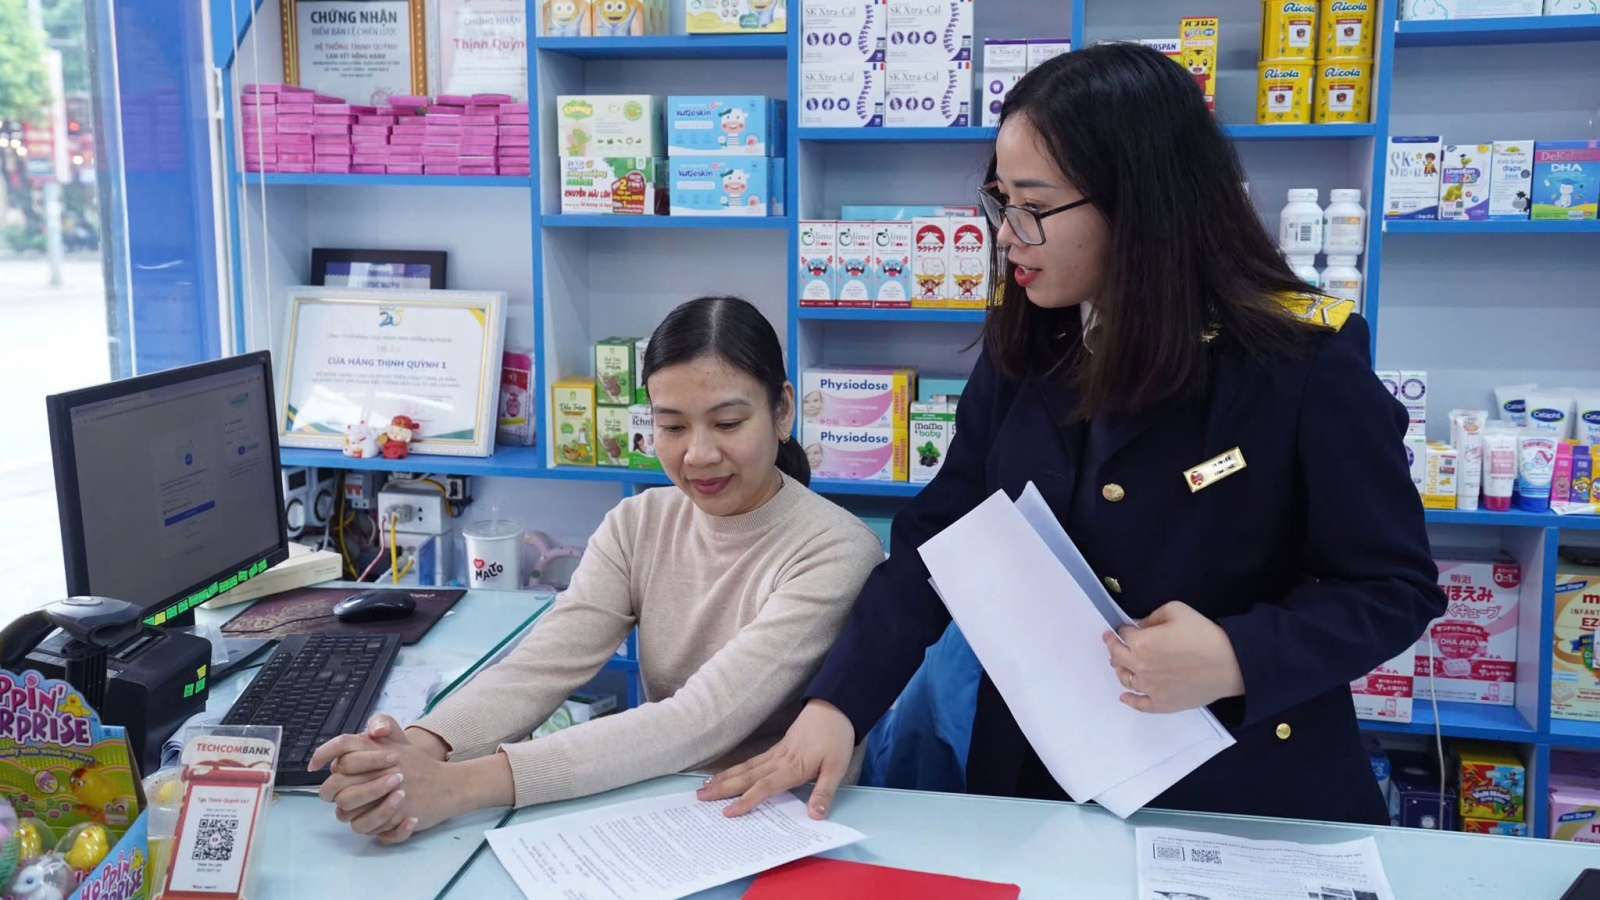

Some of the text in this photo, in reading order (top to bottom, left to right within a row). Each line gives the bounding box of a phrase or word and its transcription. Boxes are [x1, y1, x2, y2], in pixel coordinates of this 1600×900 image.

[1331, 1, 1368, 12] Ricola
[310, 7, 398, 27] CHỨNG NHẬN
[1264, 69, 1300, 78] Ricola
[1324, 68, 1361, 77] Ricola
[1550, 163, 1583, 172] DHA
[378, 359, 404, 368] THỊNH
[820, 378, 888, 391] Physiodose
[1533, 411, 1561, 420] Cetaphil
[1537, 423, 1557, 431] baby
[820, 431, 889, 444] Physiodose
[1427, 454, 1438, 494] BioGaia
[1450, 574, 1472, 584] 明治
[1438, 584, 1494, 602] ほえみ
[1459, 638, 1476, 646] ARA
[41, 748, 73, 758] wind-up
[196, 742, 271, 756] TECHCOMBANK
[1575, 812, 1592, 820] Shape
